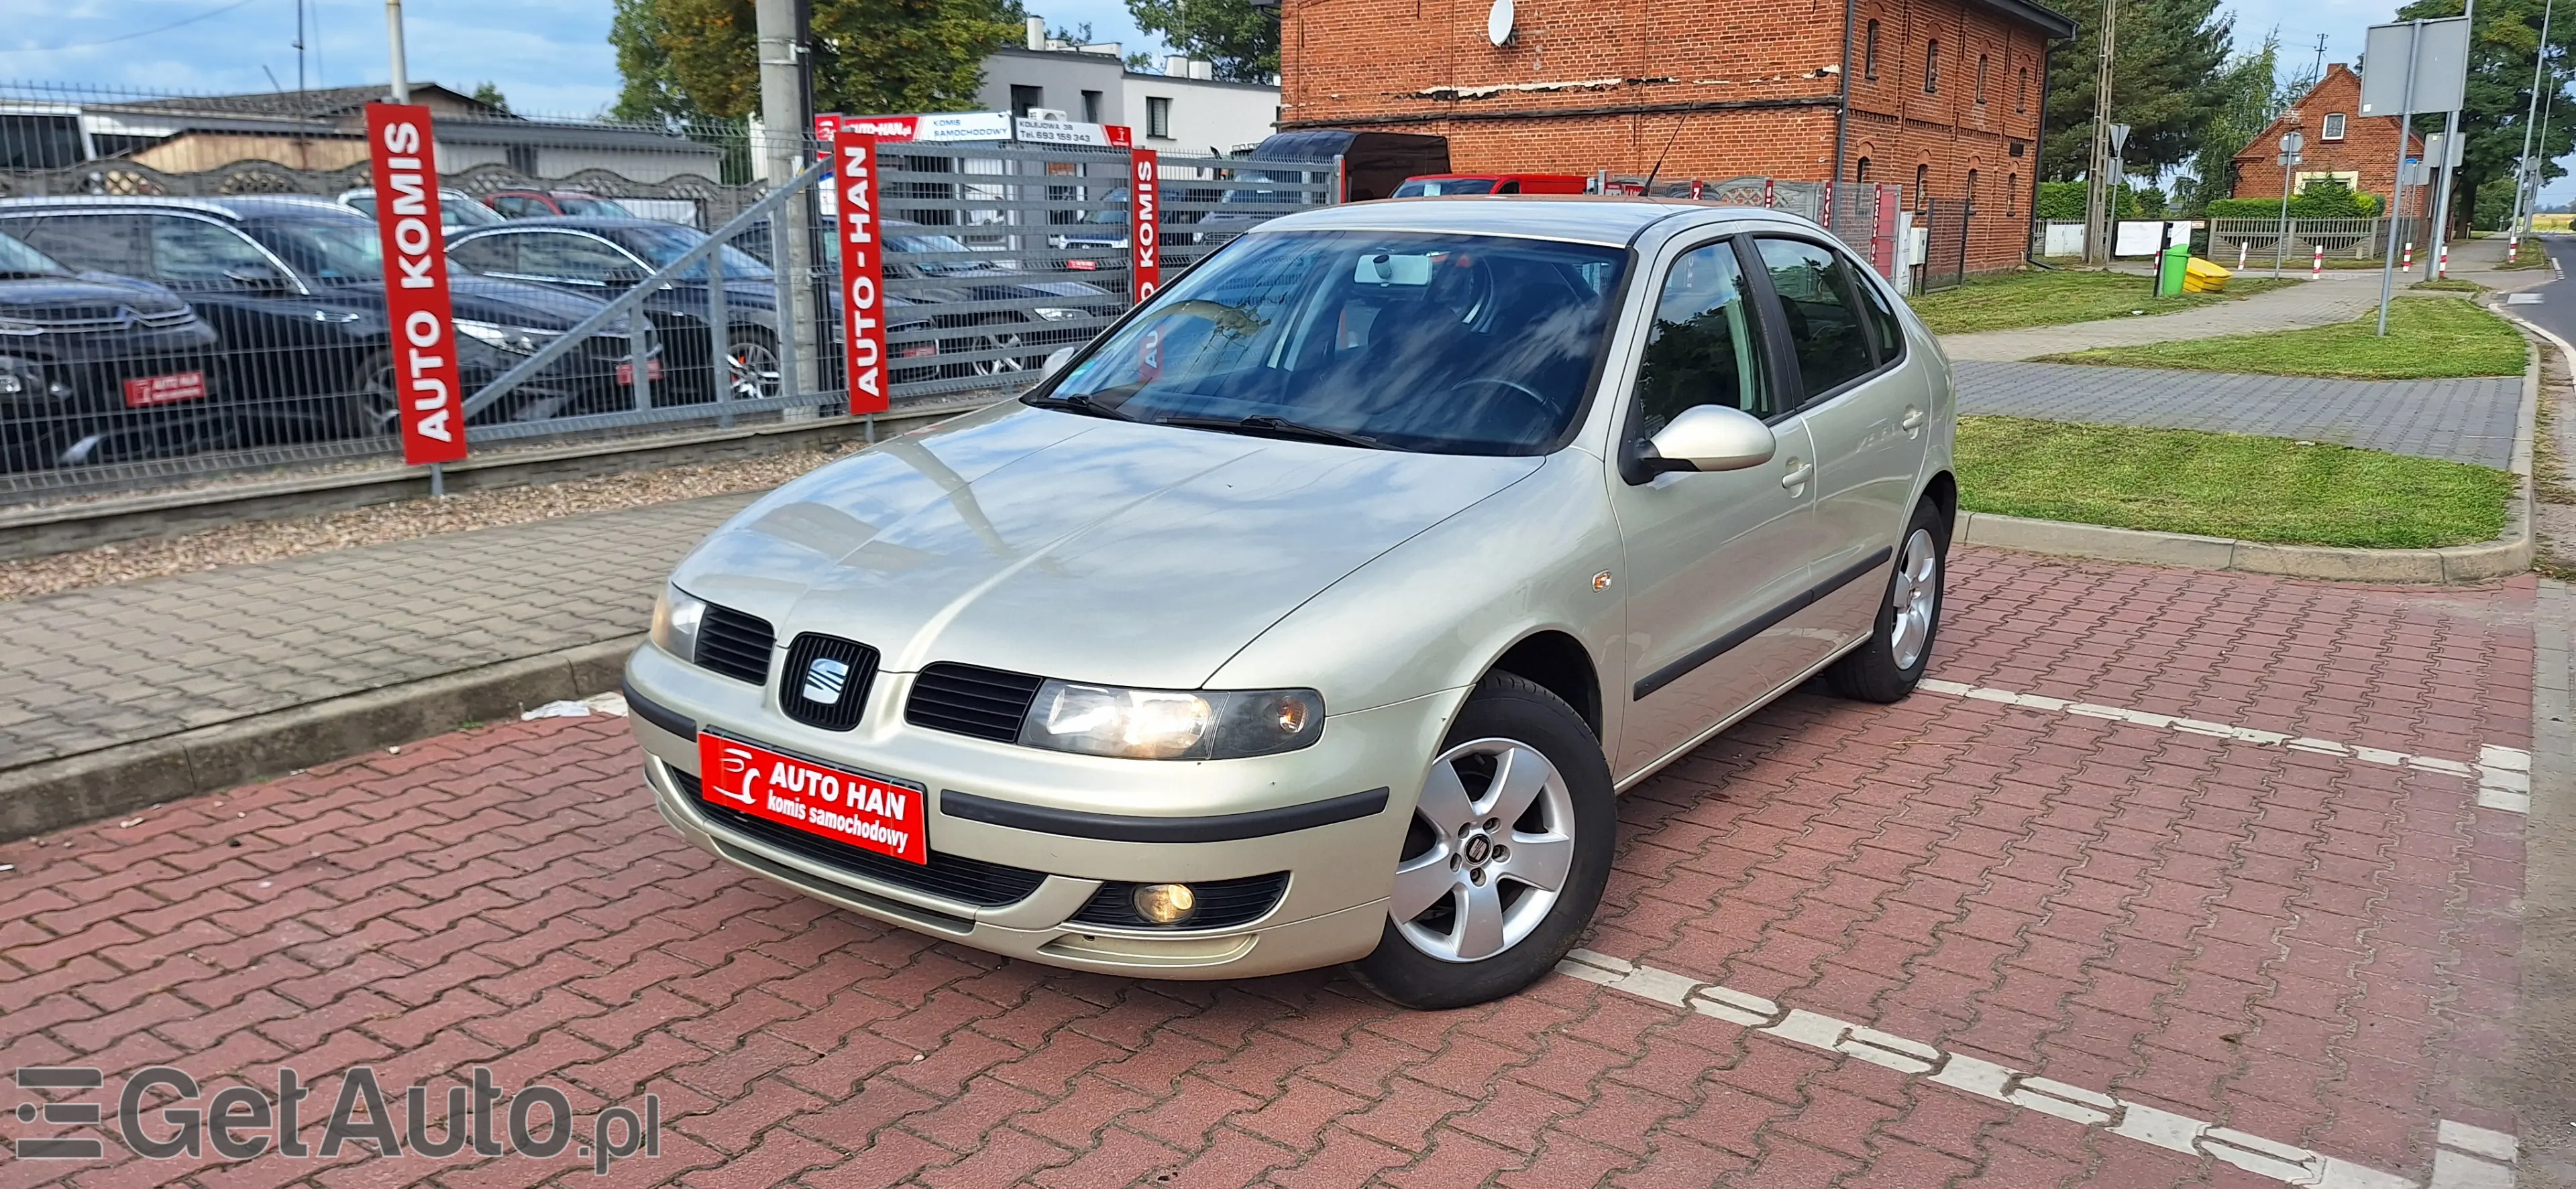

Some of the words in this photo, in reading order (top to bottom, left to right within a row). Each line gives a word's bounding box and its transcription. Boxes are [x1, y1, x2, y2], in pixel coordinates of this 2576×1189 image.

[934, 128, 1008, 137] SAMOCHODOWY
[1019, 121, 1060, 130] KOLEJOWA
[1036, 131, 1055, 139] 693
[1073, 134, 1091, 142] 343
[384, 121, 435, 289] KOMIS
[1137, 160, 1154, 268] KOMIS
[405, 309, 452, 443] AUTO
[767, 788, 806, 820] komis
[808, 806, 909, 854] samochodowy
[768, 761, 839, 802] AUTO
[846, 781, 906, 821] HAN
